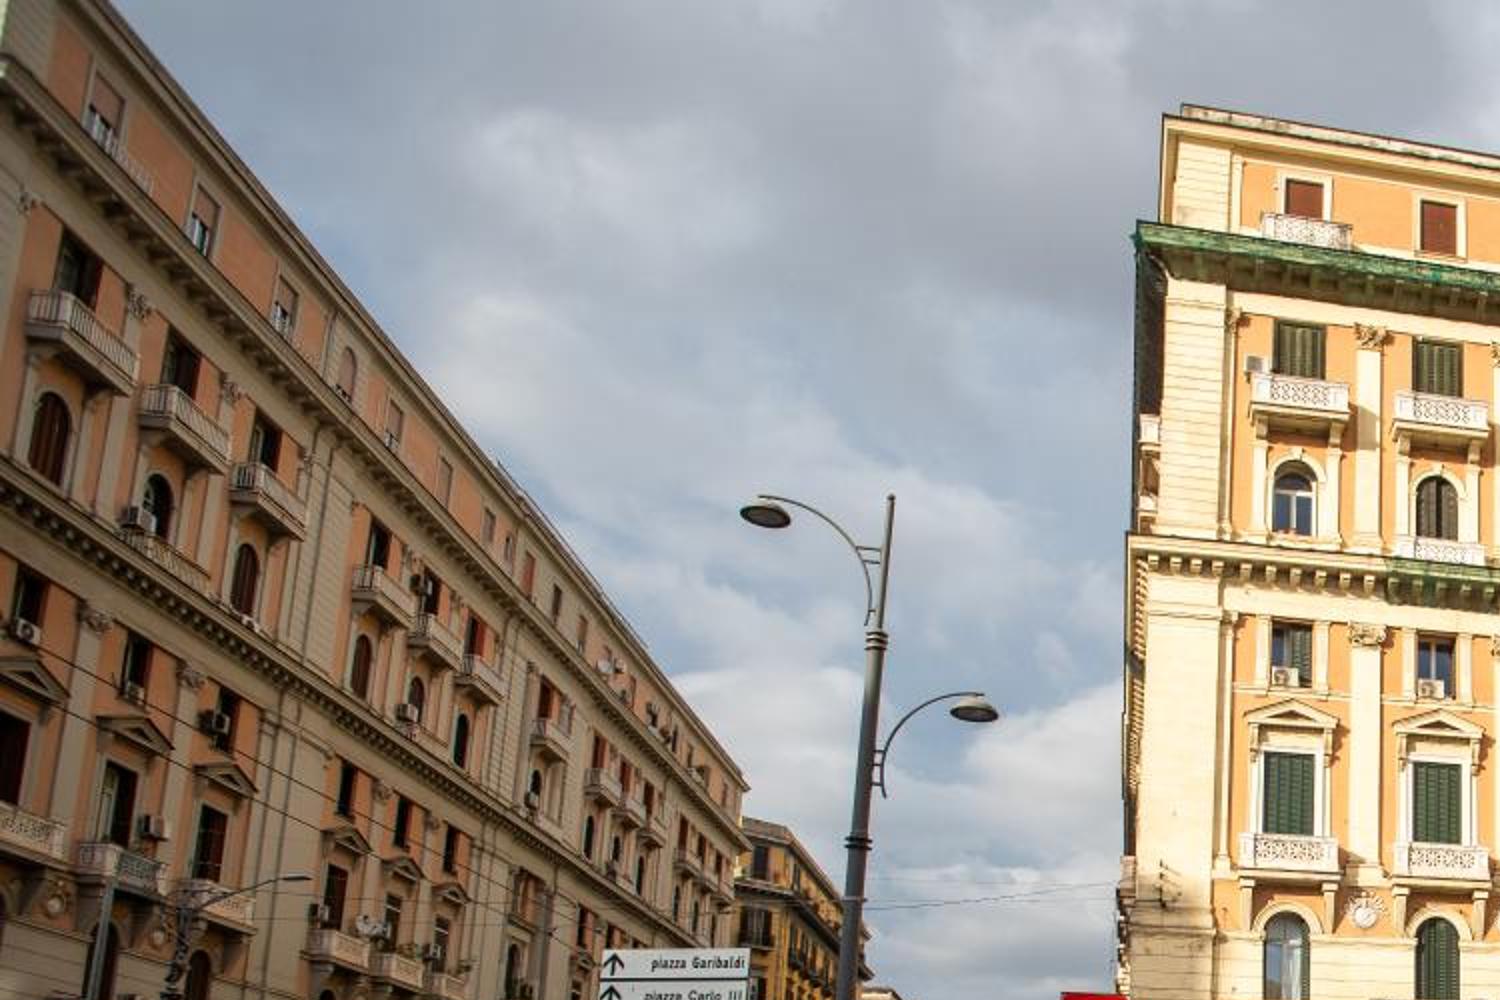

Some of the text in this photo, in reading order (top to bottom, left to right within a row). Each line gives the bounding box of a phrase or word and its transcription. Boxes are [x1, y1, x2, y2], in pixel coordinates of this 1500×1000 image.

[651, 956, 745, 972] piazza Garibaldi
[688, 990, 721, 1000] Carlo
[728, 990, 743, 1000] III
